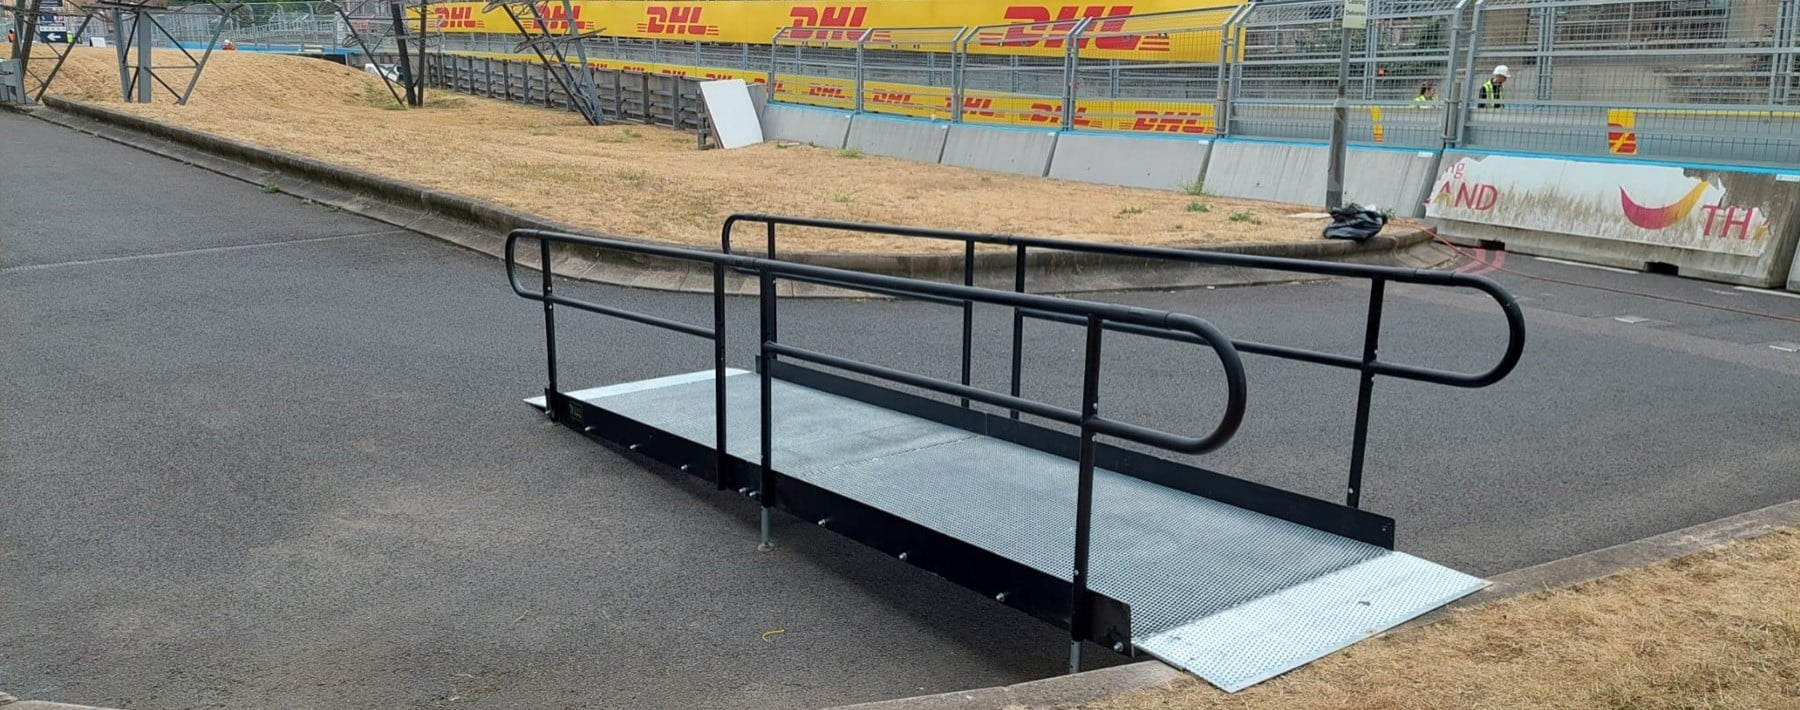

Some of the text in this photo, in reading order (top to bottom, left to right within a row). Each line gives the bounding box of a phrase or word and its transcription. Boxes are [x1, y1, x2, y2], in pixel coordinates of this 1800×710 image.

[434, 6, 476, 28] DHL
[646, 7, 706, 35] DHL
[789, 7, 866, 42] DHL
[1002, 6, 1141, 50] DHL
[1132, 111, 1205, 133] DHL
[1424, 181, 1498, 210] AND
